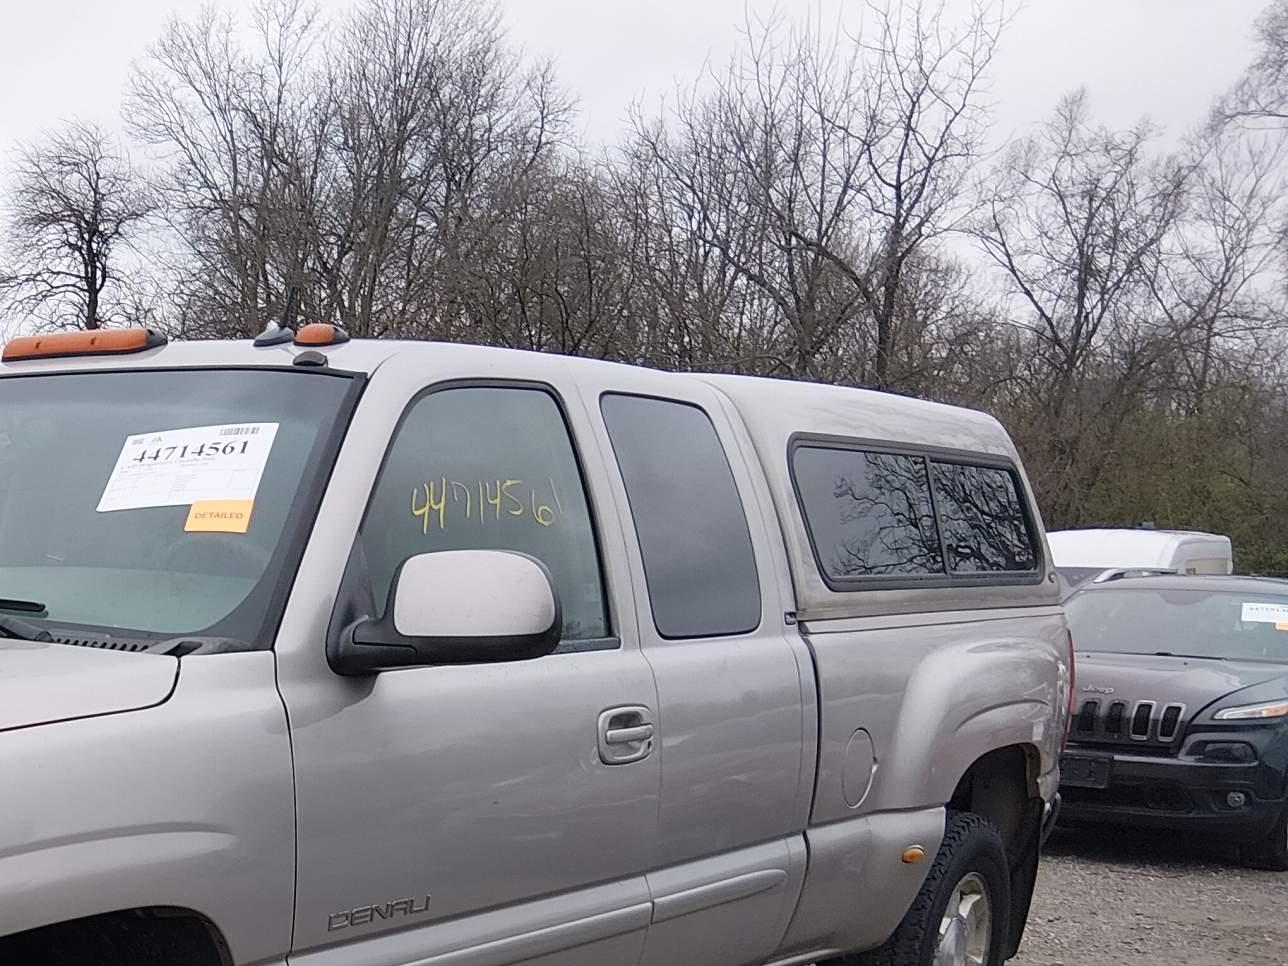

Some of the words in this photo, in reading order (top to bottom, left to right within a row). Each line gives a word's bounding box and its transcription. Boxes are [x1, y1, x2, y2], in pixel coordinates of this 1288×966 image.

[133, 439, 249, 463] 44714561
[194, 512, 244, 520] DETAILED
[411, 476, 563, 534] 44714561
[1082, 684, 1115, 696] Jeep
[328, 894, 431, 931] DENALI
